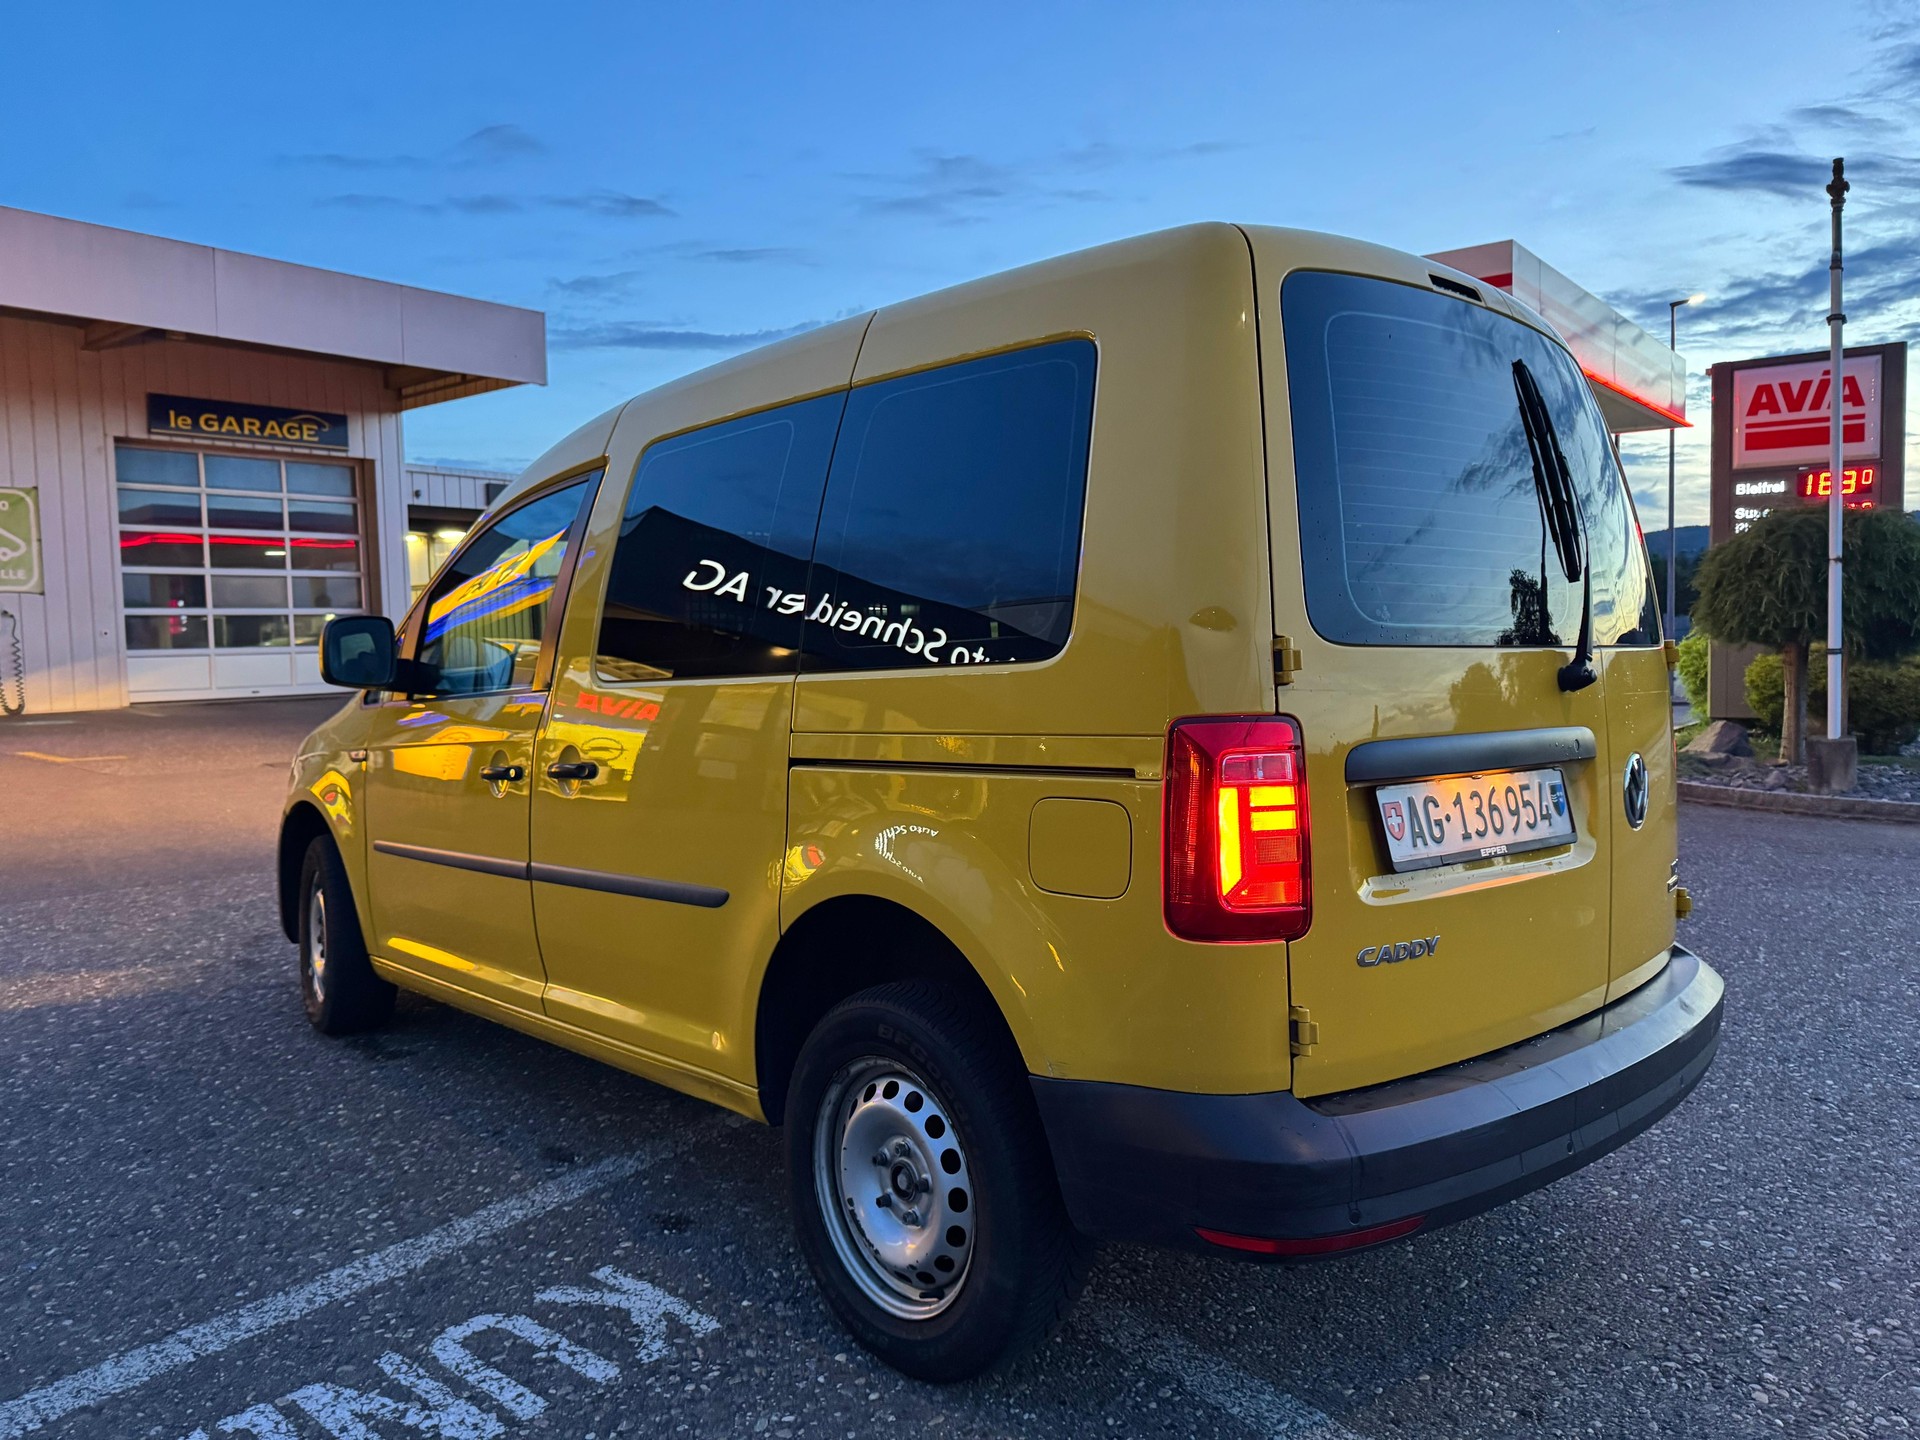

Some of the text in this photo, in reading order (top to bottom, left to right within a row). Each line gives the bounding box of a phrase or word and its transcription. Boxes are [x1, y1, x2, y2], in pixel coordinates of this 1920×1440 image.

[1745, 369, 1866, 417] AVIA
[168, 409, 320, 442] le GARAGE
[1735, 480, 1785, 496] Bleifrei
[1734, 507, 1774, 521] Supe
[1480, 845, 1508, 858] EPPER
[1357, 934, 1441, 967] CADDY
